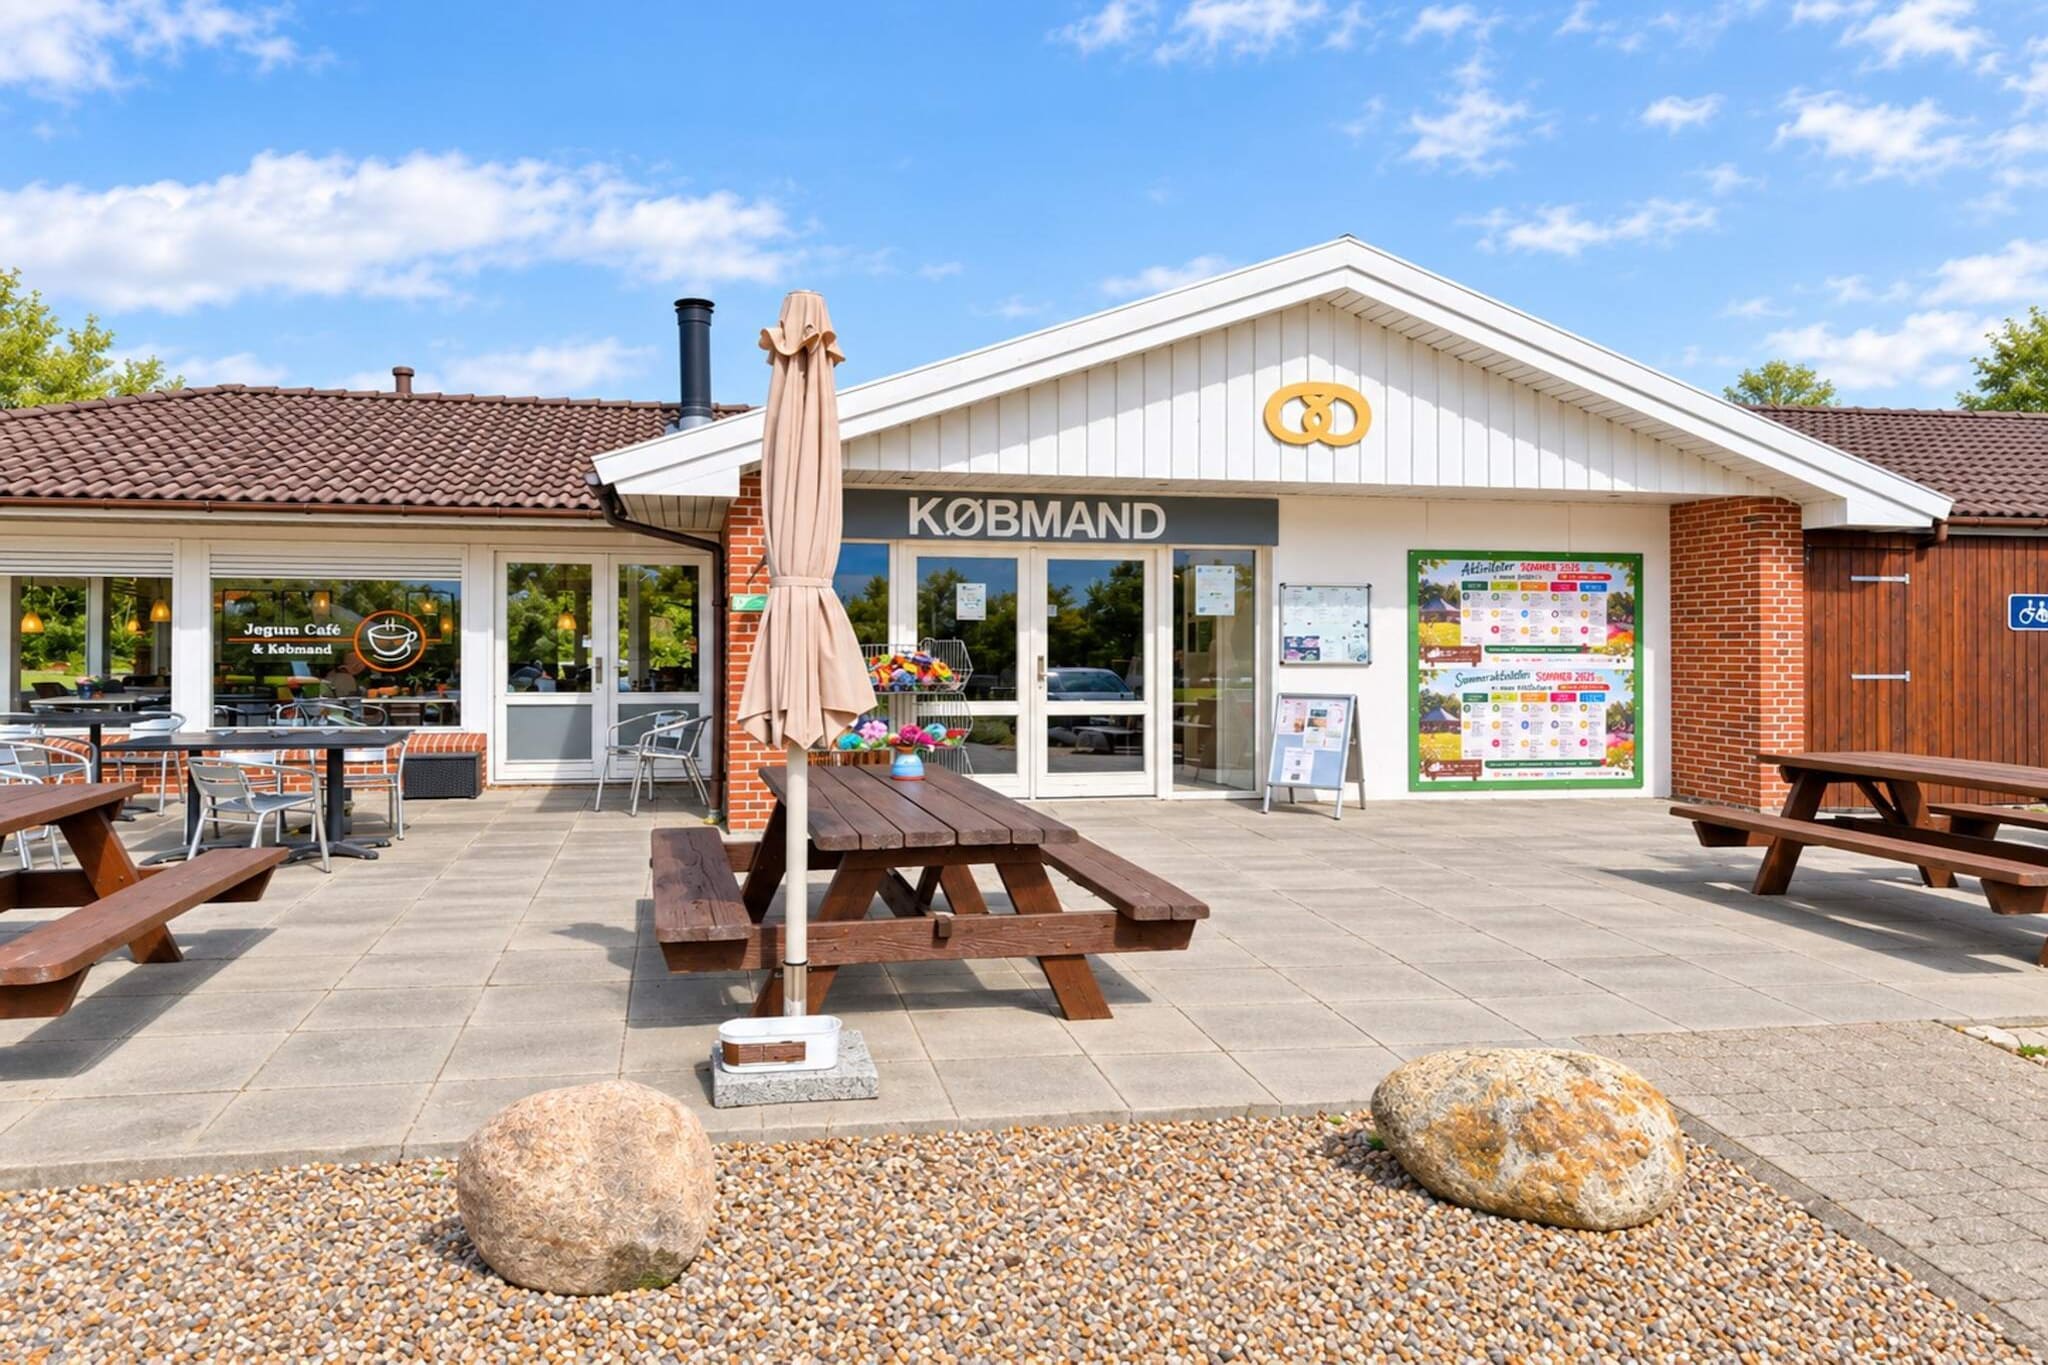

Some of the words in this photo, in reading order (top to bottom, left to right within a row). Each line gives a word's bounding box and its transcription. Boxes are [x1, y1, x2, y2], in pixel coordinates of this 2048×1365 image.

[908, 497, 1166, 540] KØBMAND
[244, 623, 299, 638] Jegum
[304, 623, 341, 636] Café
[251, 643, 264, 654] &
